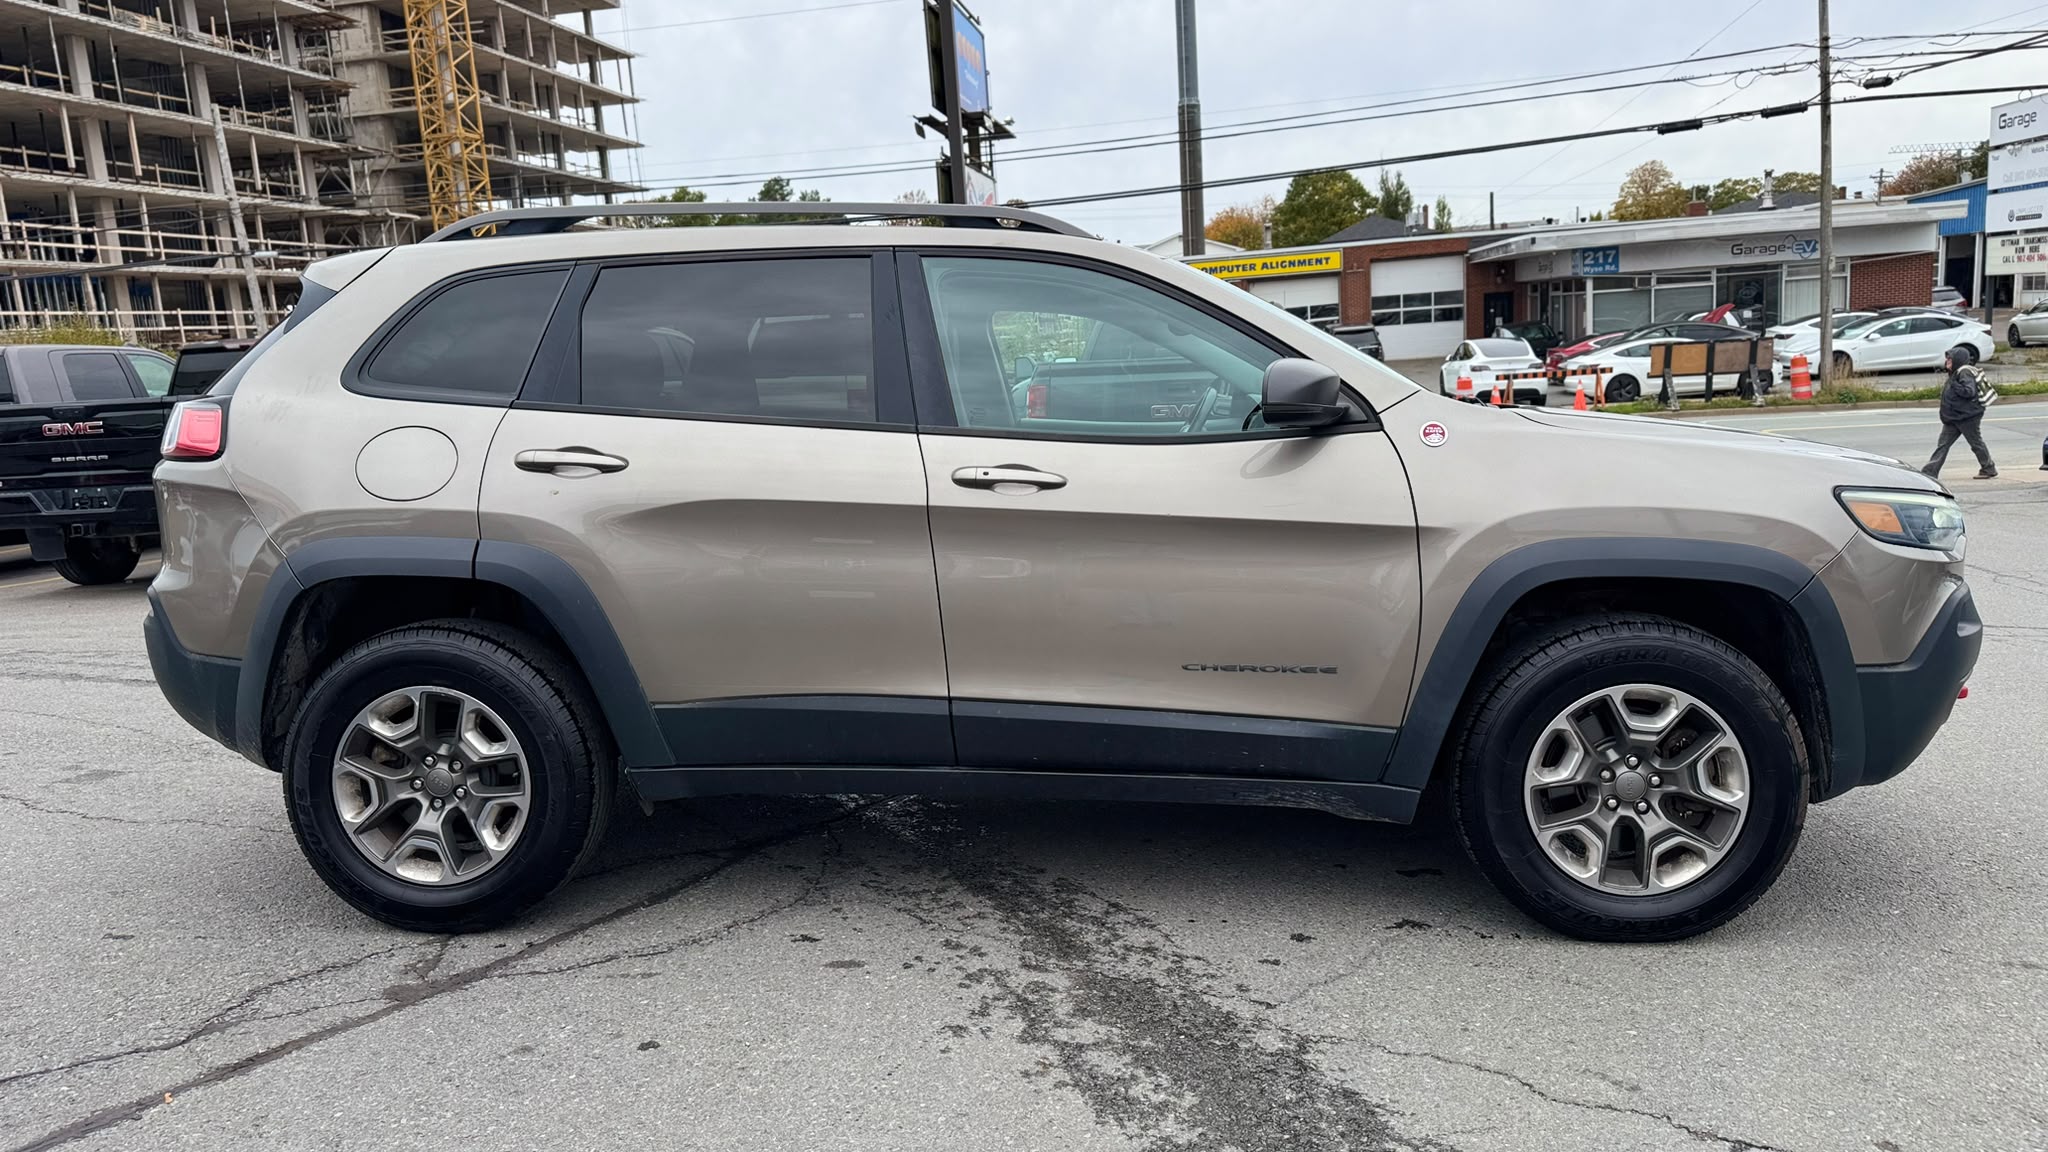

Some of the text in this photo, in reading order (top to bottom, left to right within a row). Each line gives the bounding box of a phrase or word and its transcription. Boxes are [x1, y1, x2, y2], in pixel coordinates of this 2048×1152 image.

[1998, 111, 2037, 129] Garage
[1261, 257, 1331, 270] ALIGNMENT
[1584, 250, 1616, 264] 217
[1151, 403, 1196, 419] GM
[42, 421, 104, 437] GMC
[51, 454, 109, 463] SIERRA
[1181, 663, 1339, 674] CHEROKEE
